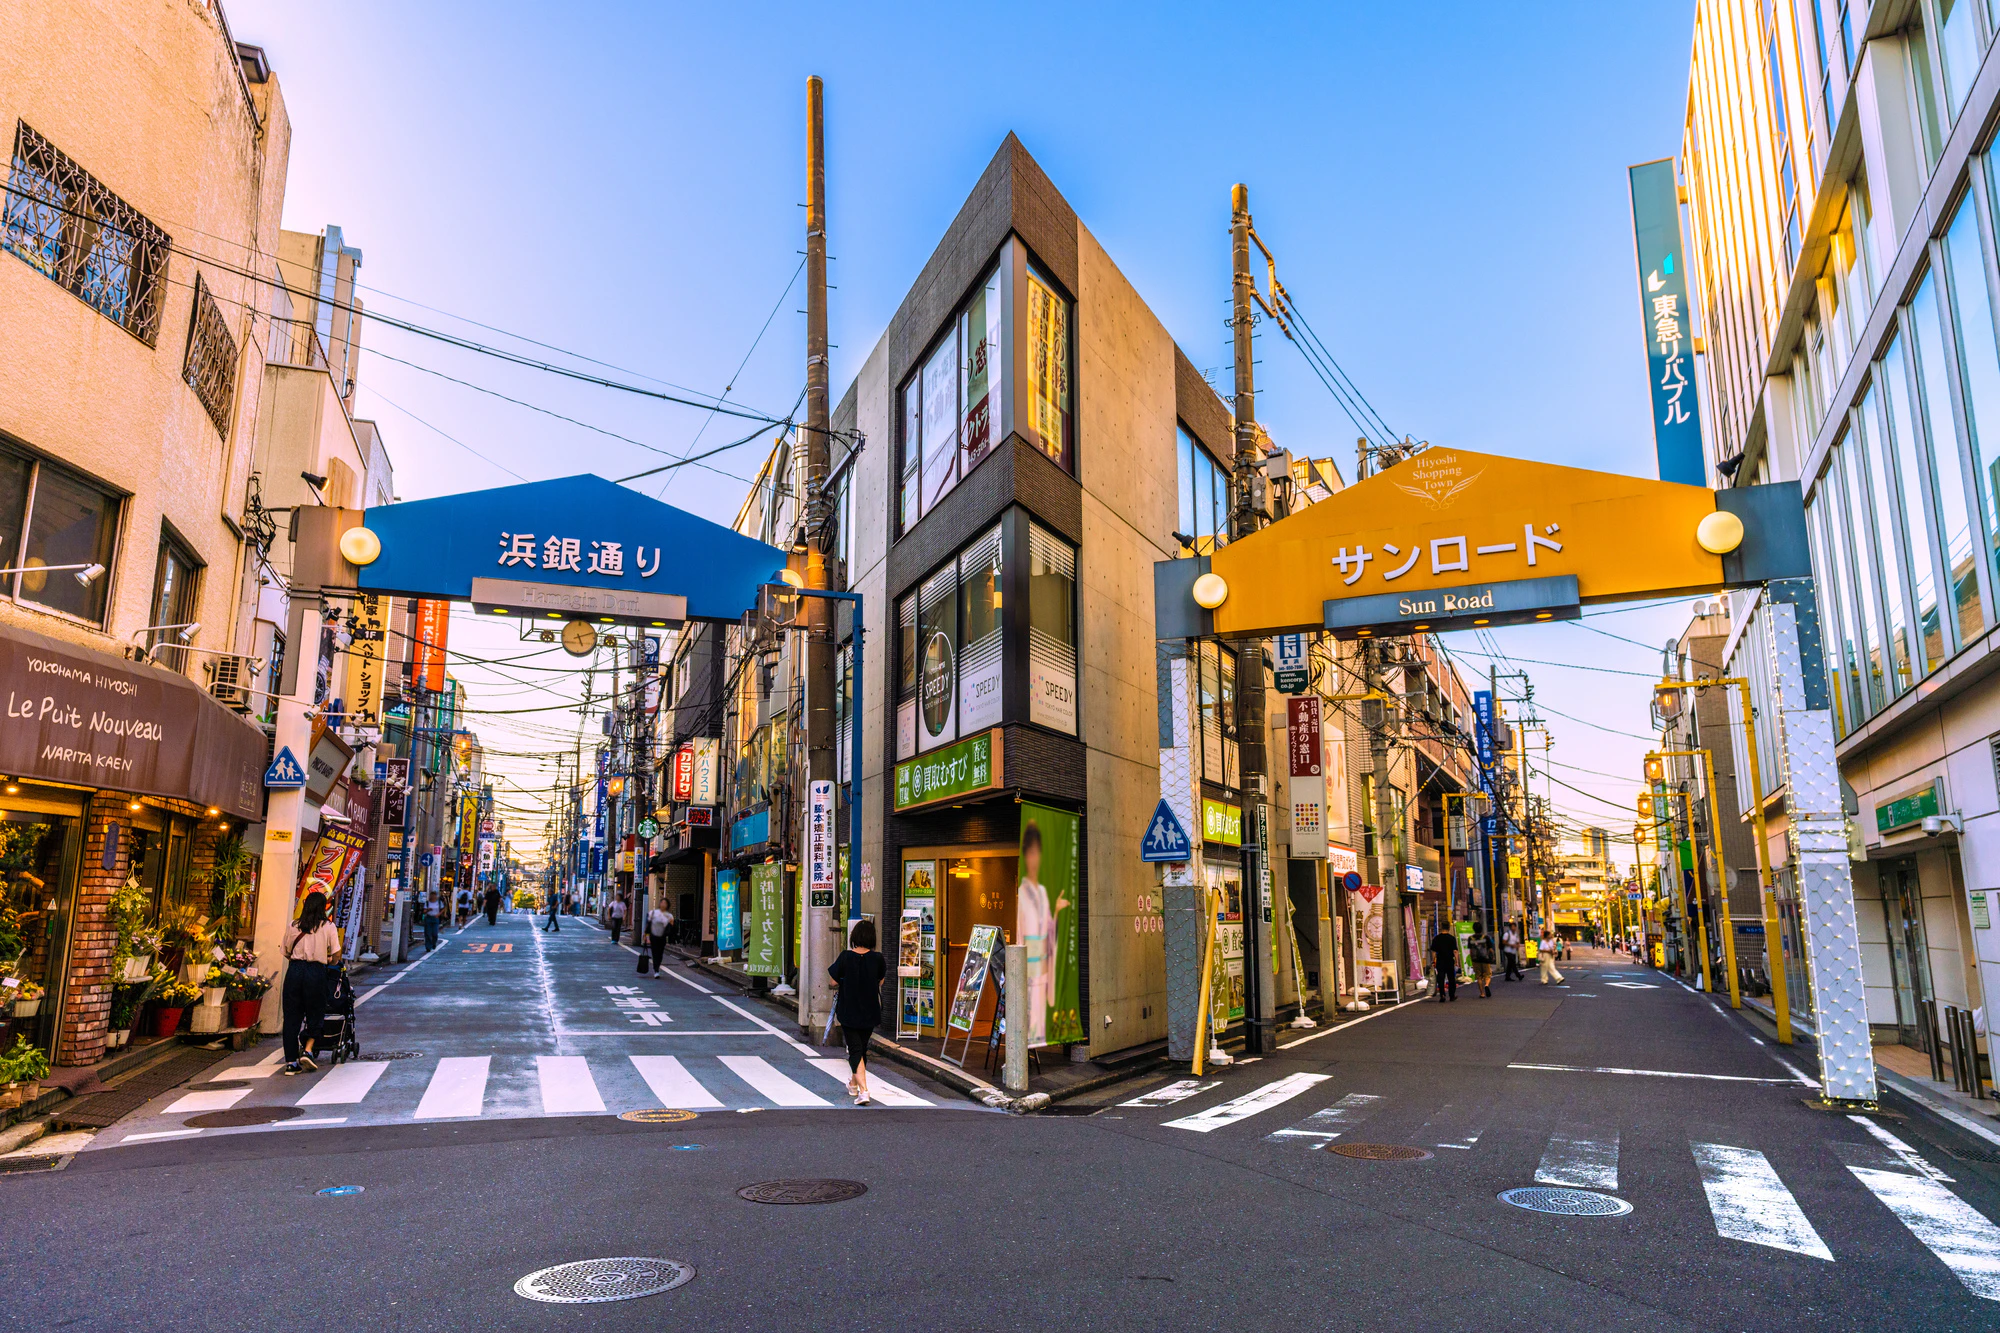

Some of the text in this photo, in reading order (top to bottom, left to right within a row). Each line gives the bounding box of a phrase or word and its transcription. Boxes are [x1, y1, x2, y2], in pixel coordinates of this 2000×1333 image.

[1652, 294, 1691, 426] 東急リバブル
[1412, 465, 1463, 481] Shopping
[1416, 453, 1458, 469] Hiyoshi
[1422, 477, 1454, 490] Town
[497, 531, 662, 579] 浜銀通り
[1331, 522, 1563, 586] サンロード
[521, 586, 641, 613] Hamagin Dori
[1399, 589, 1495, 616] Sun Road
[364, 631, 377, 639] 1F
[26, 656, 138, 697] YOKOHAMA HIYOSHI
[358, 642, 375, 708] ペットショップ
[924, 672, 950, 700] SPEEDY
[975, 673, 1001, 698] SPEEDY
[1280, 682, 1295, 690] co.jp
[1045, 681, 1073, 705] SPEEDY
[7, 691, 163, 742] Le Puit Nouveau
[1310, 700, 1319, 734] 賃貸・売買
[1298, 700, 1311, 765] 不動産の窓口
[41, 744, 133, 771] NARITA KAEN
[973, 741, 988, 763] 査定
[679, 752, 692, 793] カラオケ
[700, 759, 710, 802] ハウスコム
[899, 766, 909, 785] 高価
[922, 752, 969, 793] 買取むすび
[973, 762, 988, 784] 無料
[388, 764, 401, 820] 楽ケット
[899, 786, 909, 805] 買取
[353, 802, 368, 825] RAKU
[326, 827, 366, 849] 高価買取
[987, 899, 1004, 910] むすび
[1356, 909, 1364, 949] 高価買取
[461, 943, 514, 953] 30
